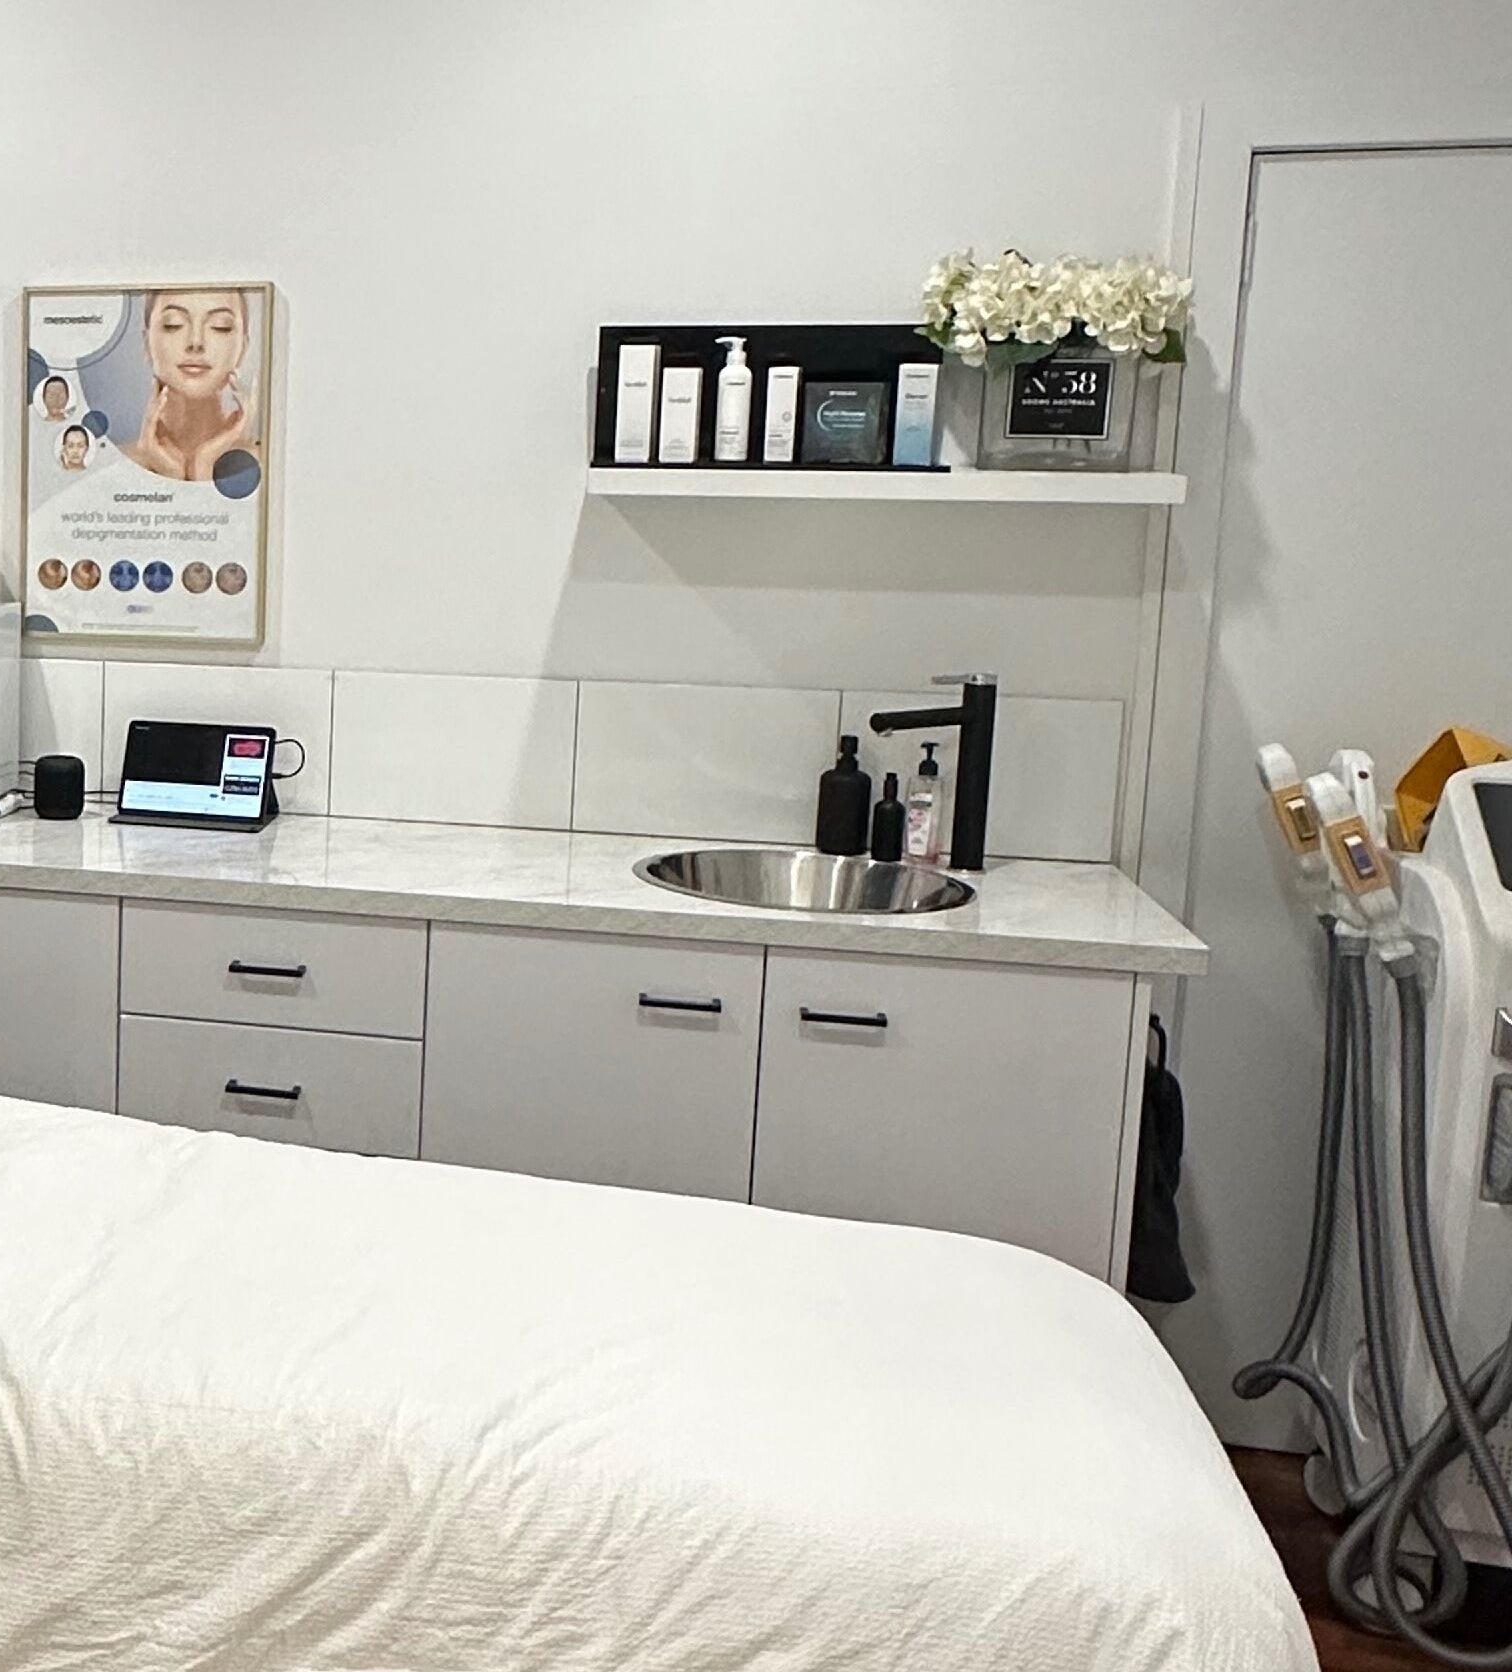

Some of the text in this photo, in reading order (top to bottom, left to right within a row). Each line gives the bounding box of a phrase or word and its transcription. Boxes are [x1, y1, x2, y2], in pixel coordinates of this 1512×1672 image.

[1061, 370, 1097, 394] 58
[61, 511, 229, 526] world's leading professional
[71, 528, 218, 542] depigmentation method
